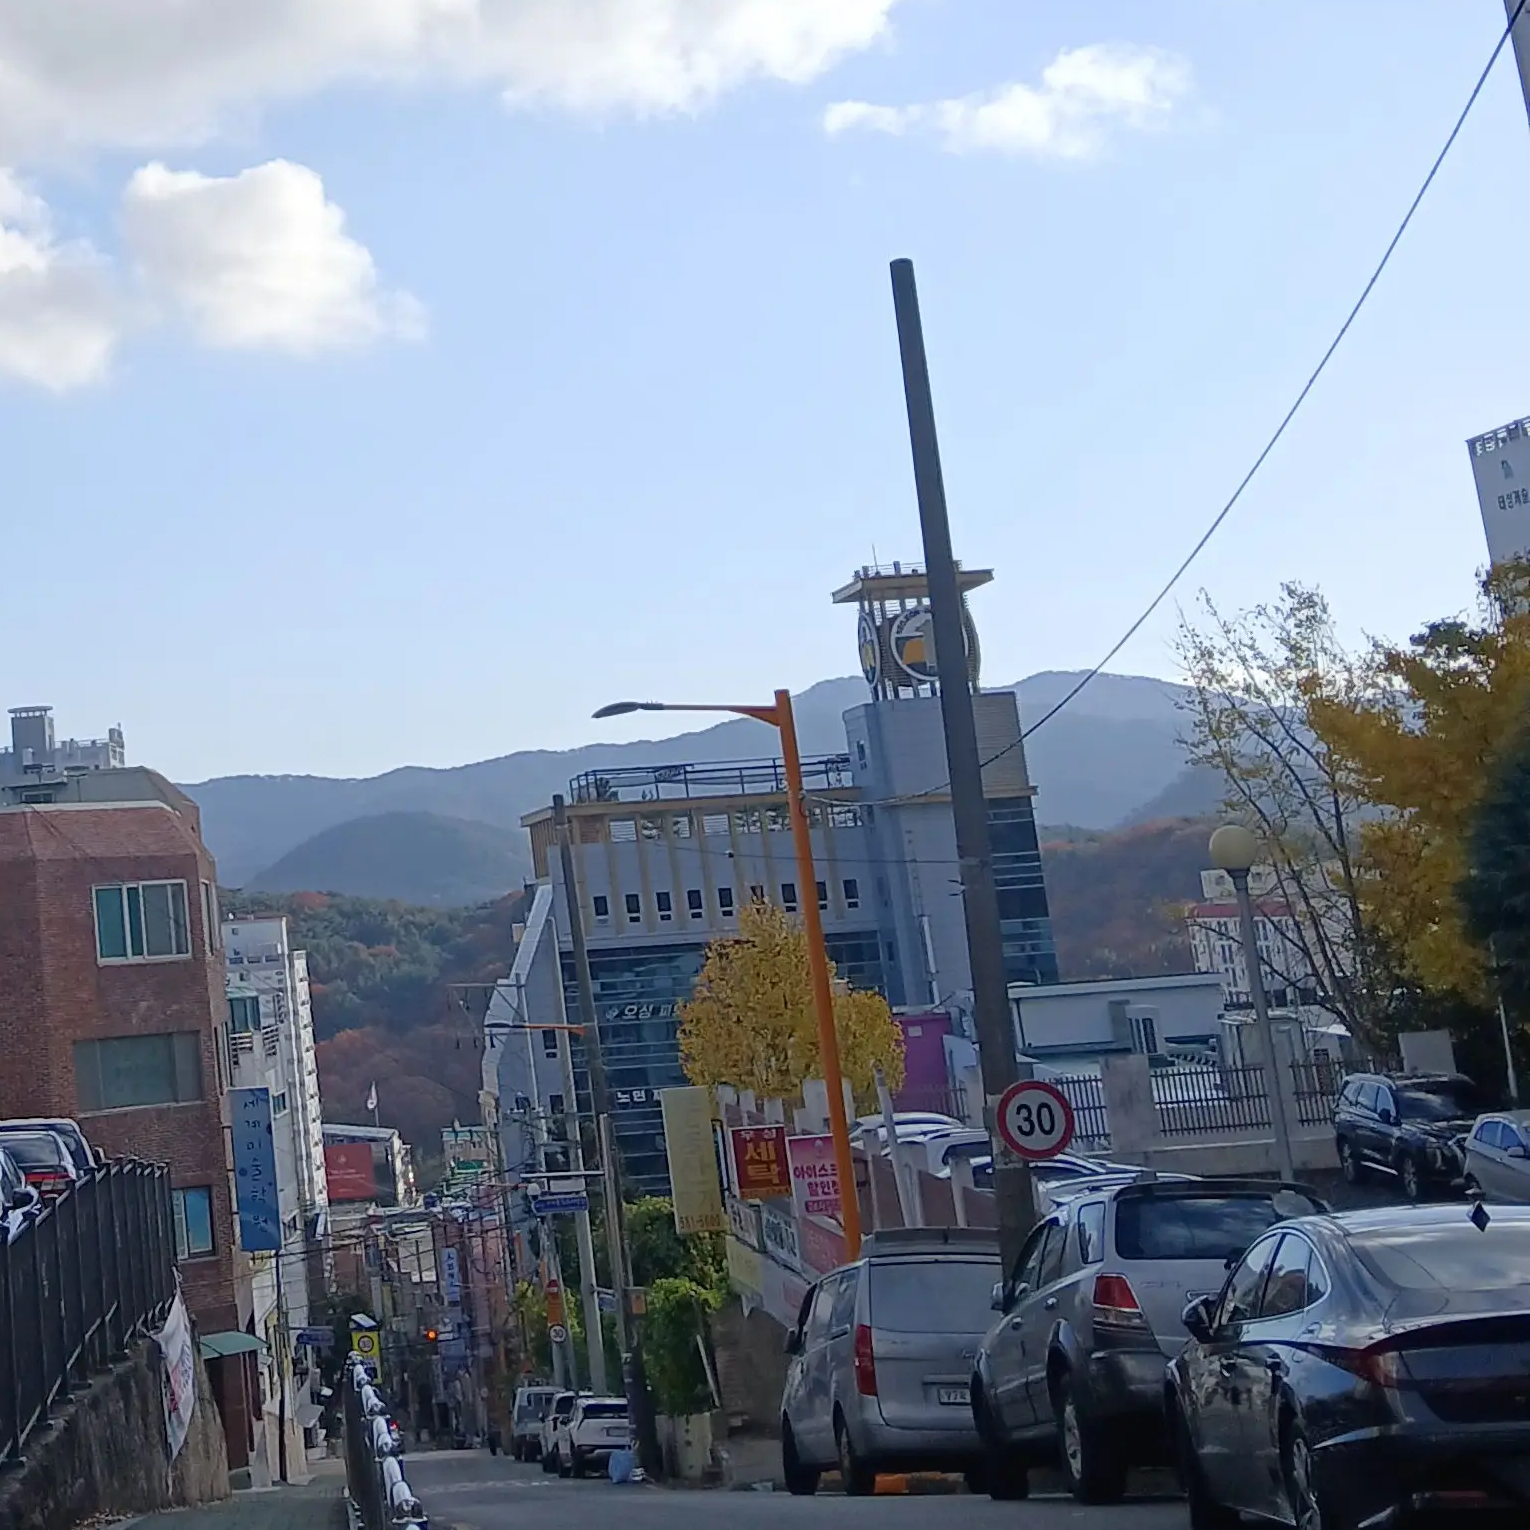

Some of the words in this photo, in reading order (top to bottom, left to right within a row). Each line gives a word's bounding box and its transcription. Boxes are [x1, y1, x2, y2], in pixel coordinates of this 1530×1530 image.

[1016, 1102, 1055, 1136] 30
[745, 1141, 780, 1184] 세탁
[793, 1163, 838, 1179] 아이스크
